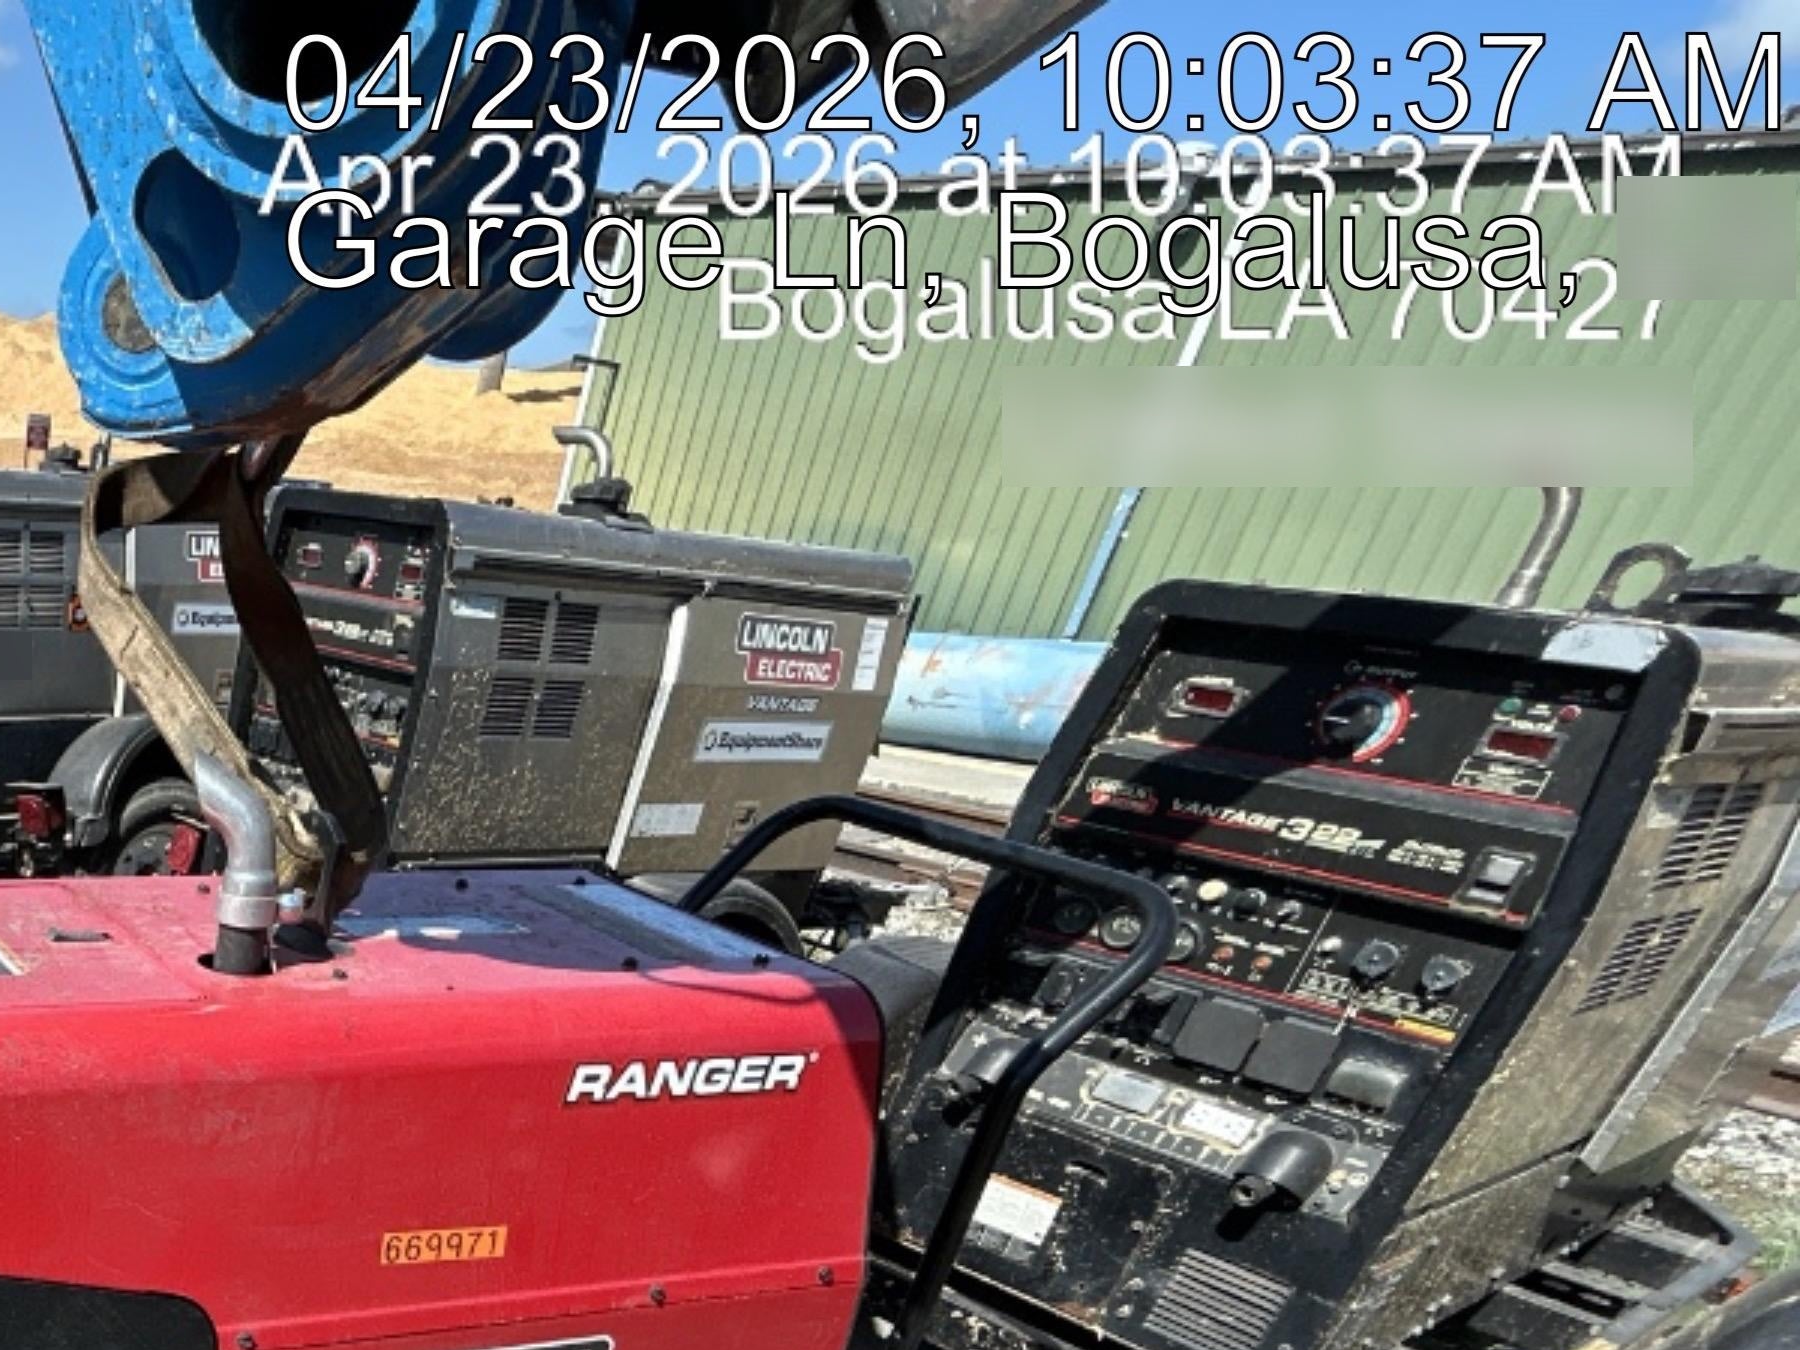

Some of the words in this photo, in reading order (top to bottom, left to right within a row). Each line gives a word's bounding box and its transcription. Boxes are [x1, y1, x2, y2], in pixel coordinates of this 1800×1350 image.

[741, 620, 830, 654] LINCOLN
[756, 658, 833, 683] ELECTRIC
[566, 1054, 807, 1104] RANGER
[386, 1229, 499, 1264] 669971
